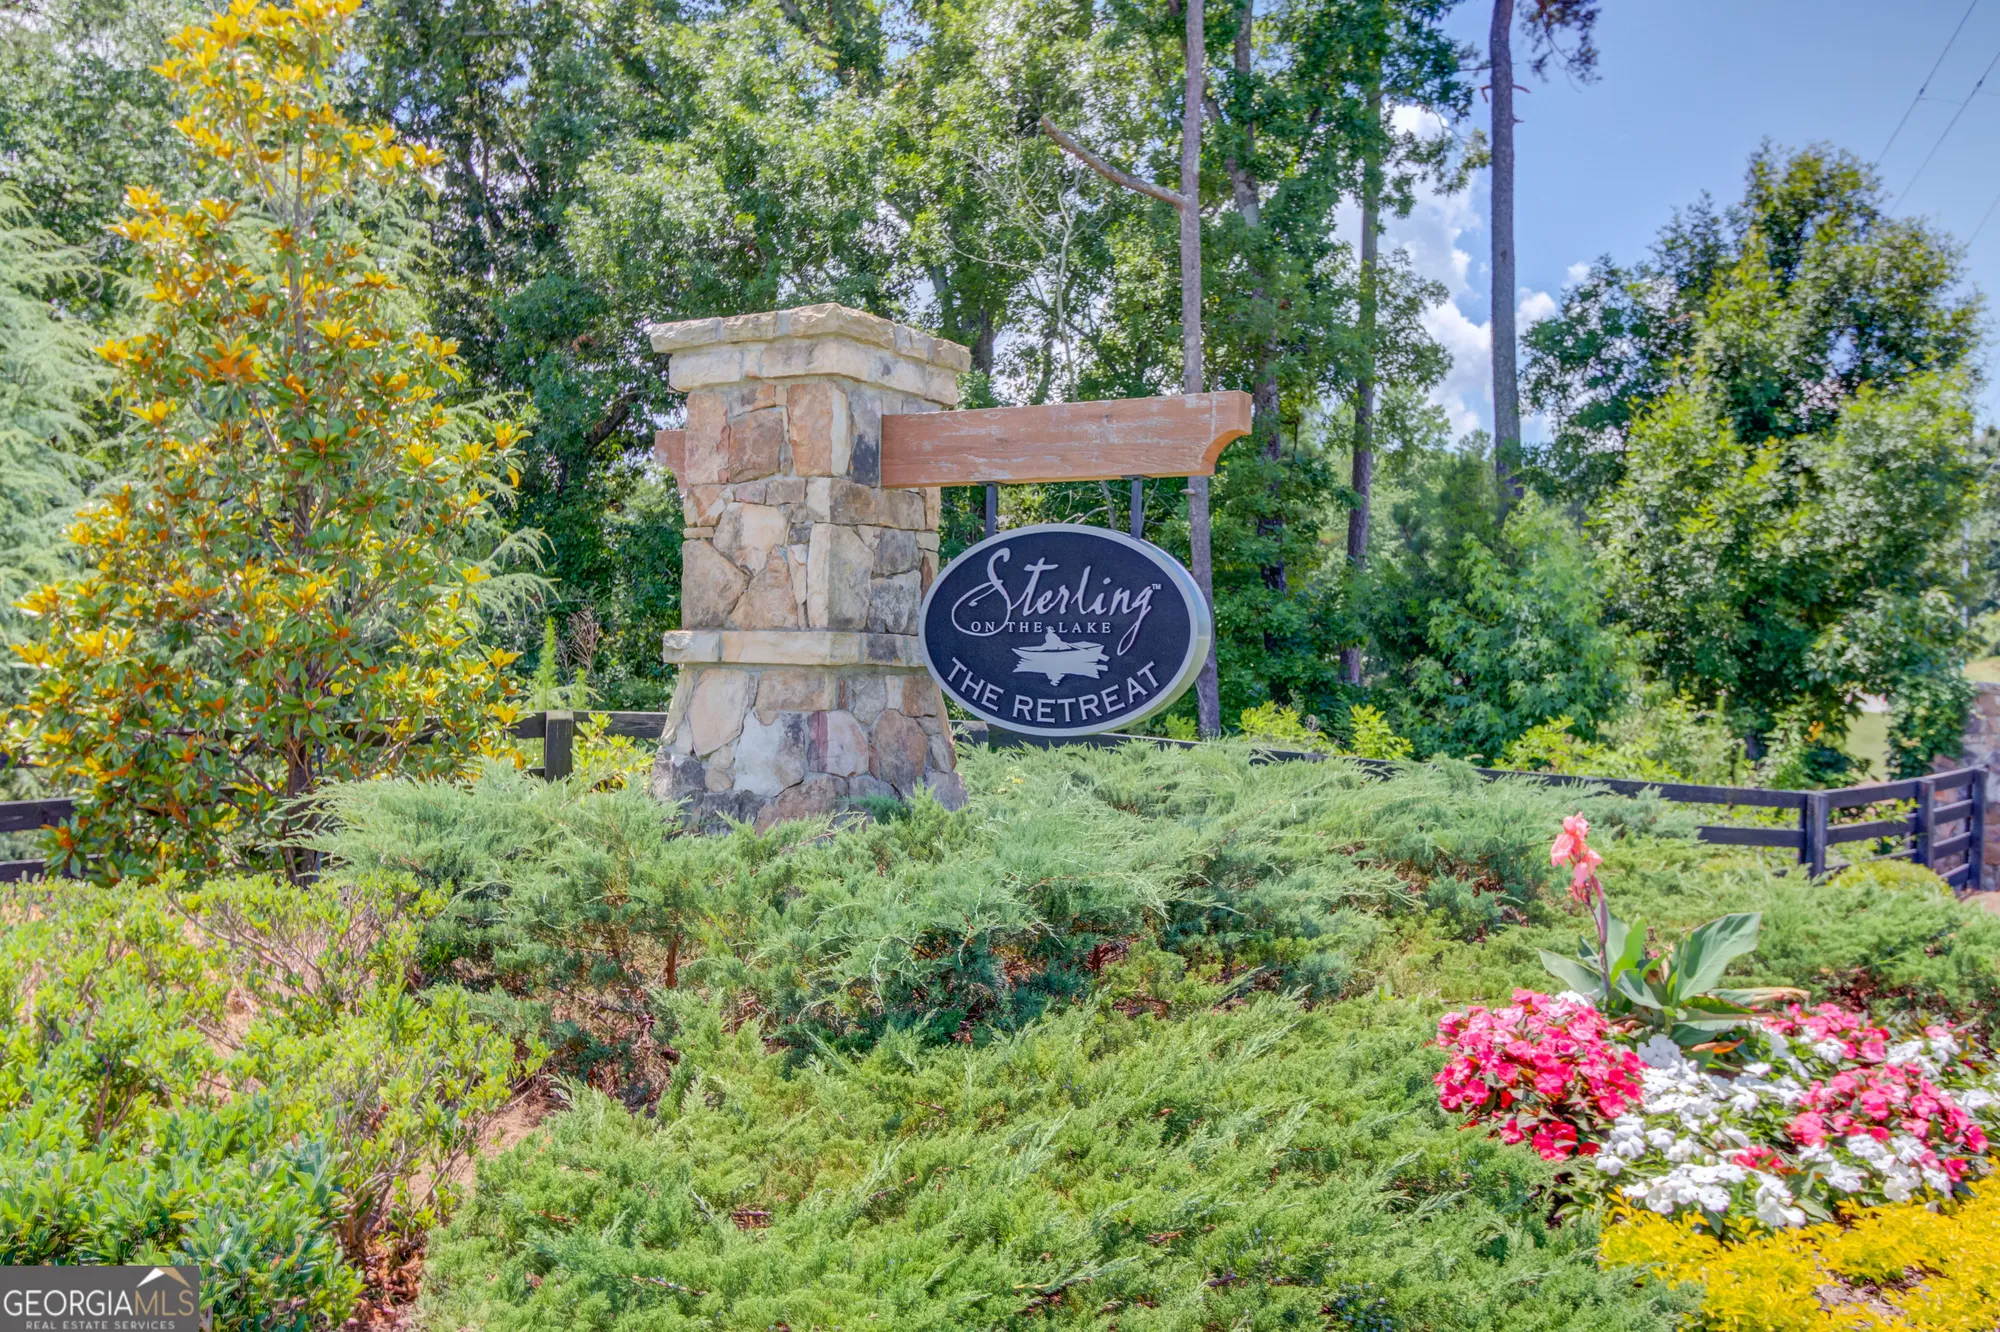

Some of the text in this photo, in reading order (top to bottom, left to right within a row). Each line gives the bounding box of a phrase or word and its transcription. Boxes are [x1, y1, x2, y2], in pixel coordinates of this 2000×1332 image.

[971, 621, 1112, 634] ON THE LAKE
[946, 656, 1160, 724] THE RETREAT
